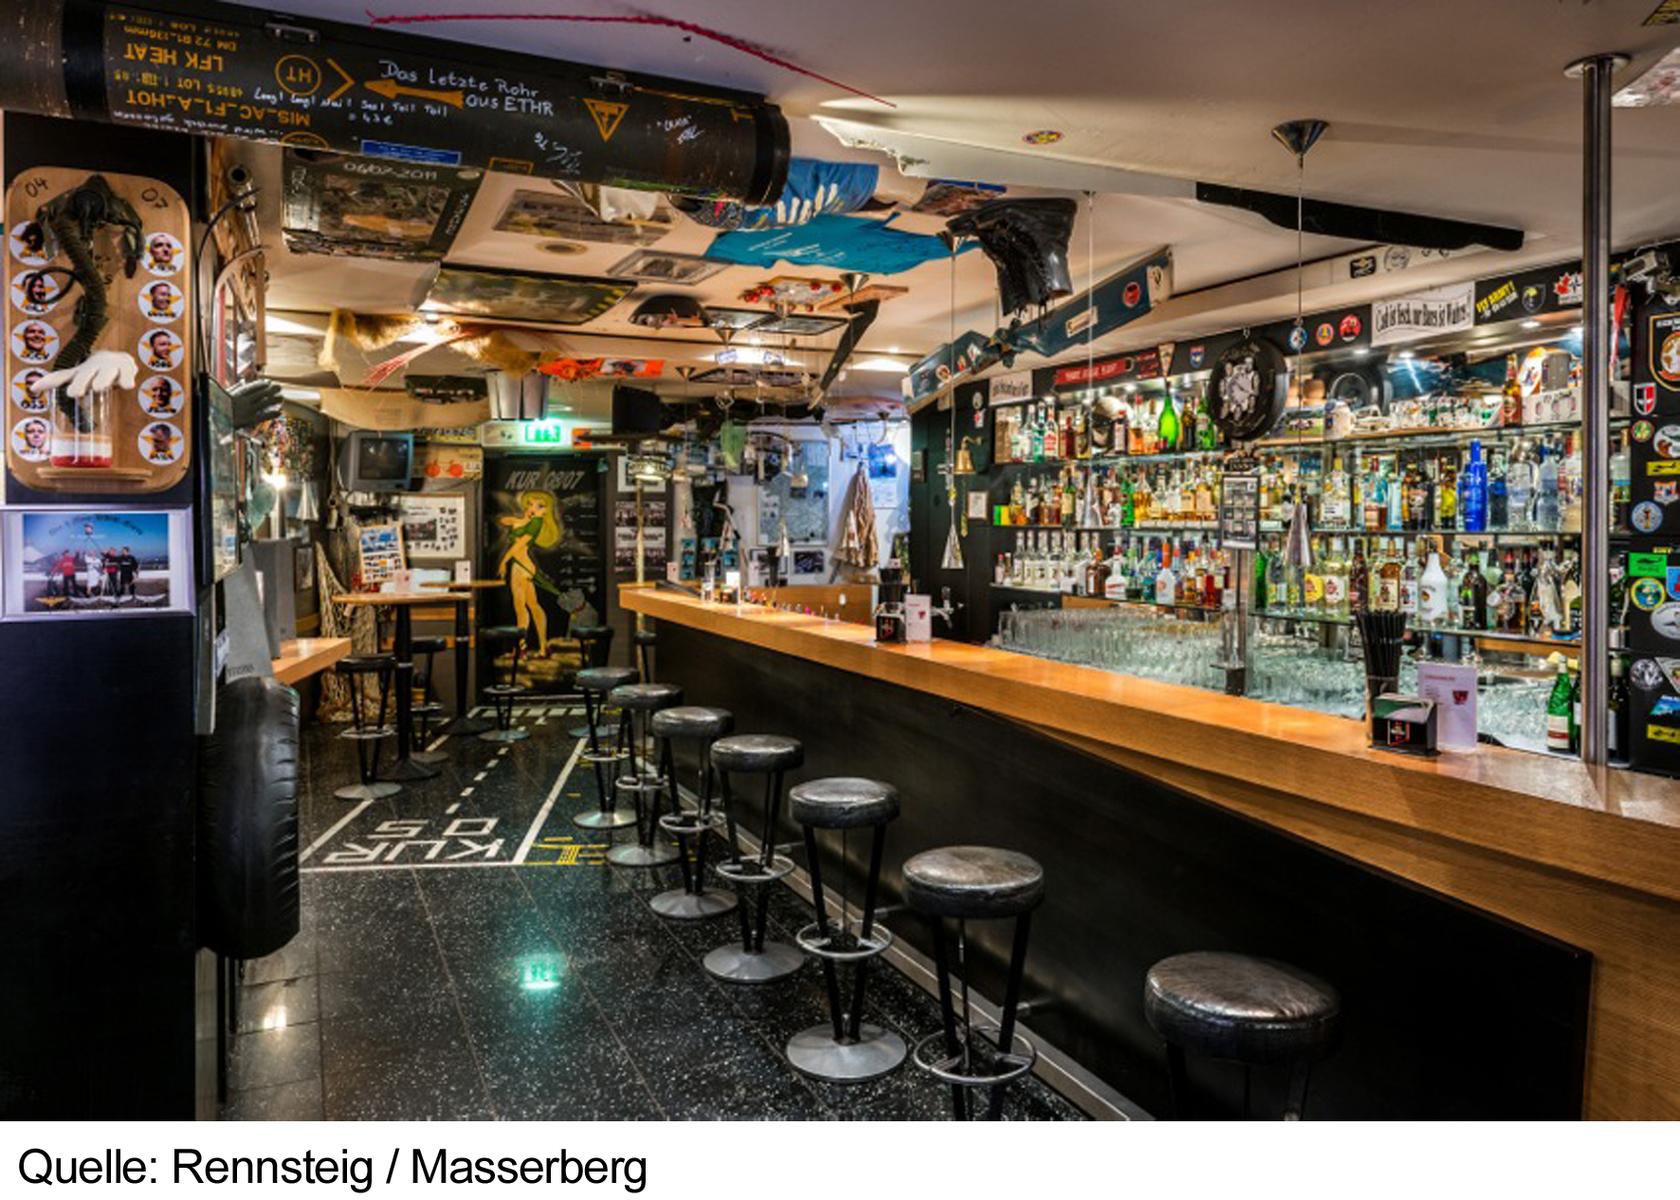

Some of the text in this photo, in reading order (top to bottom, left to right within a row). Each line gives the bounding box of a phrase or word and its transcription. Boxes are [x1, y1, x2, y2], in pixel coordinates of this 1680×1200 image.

[123, 43, 223, 72] LFK HEAT
[177, 77, 201, 92] LOT
[285, 65, 312, 84] HT
[379, 60, 417, 83] Das
[495, 78, 539, 99] Rohr
[503, 94, 554, 117] ETHR
[25, 175, 49, 199] 04
[505, 470, 541, 490] KUR
[321, 837, 505, 865] KUR
